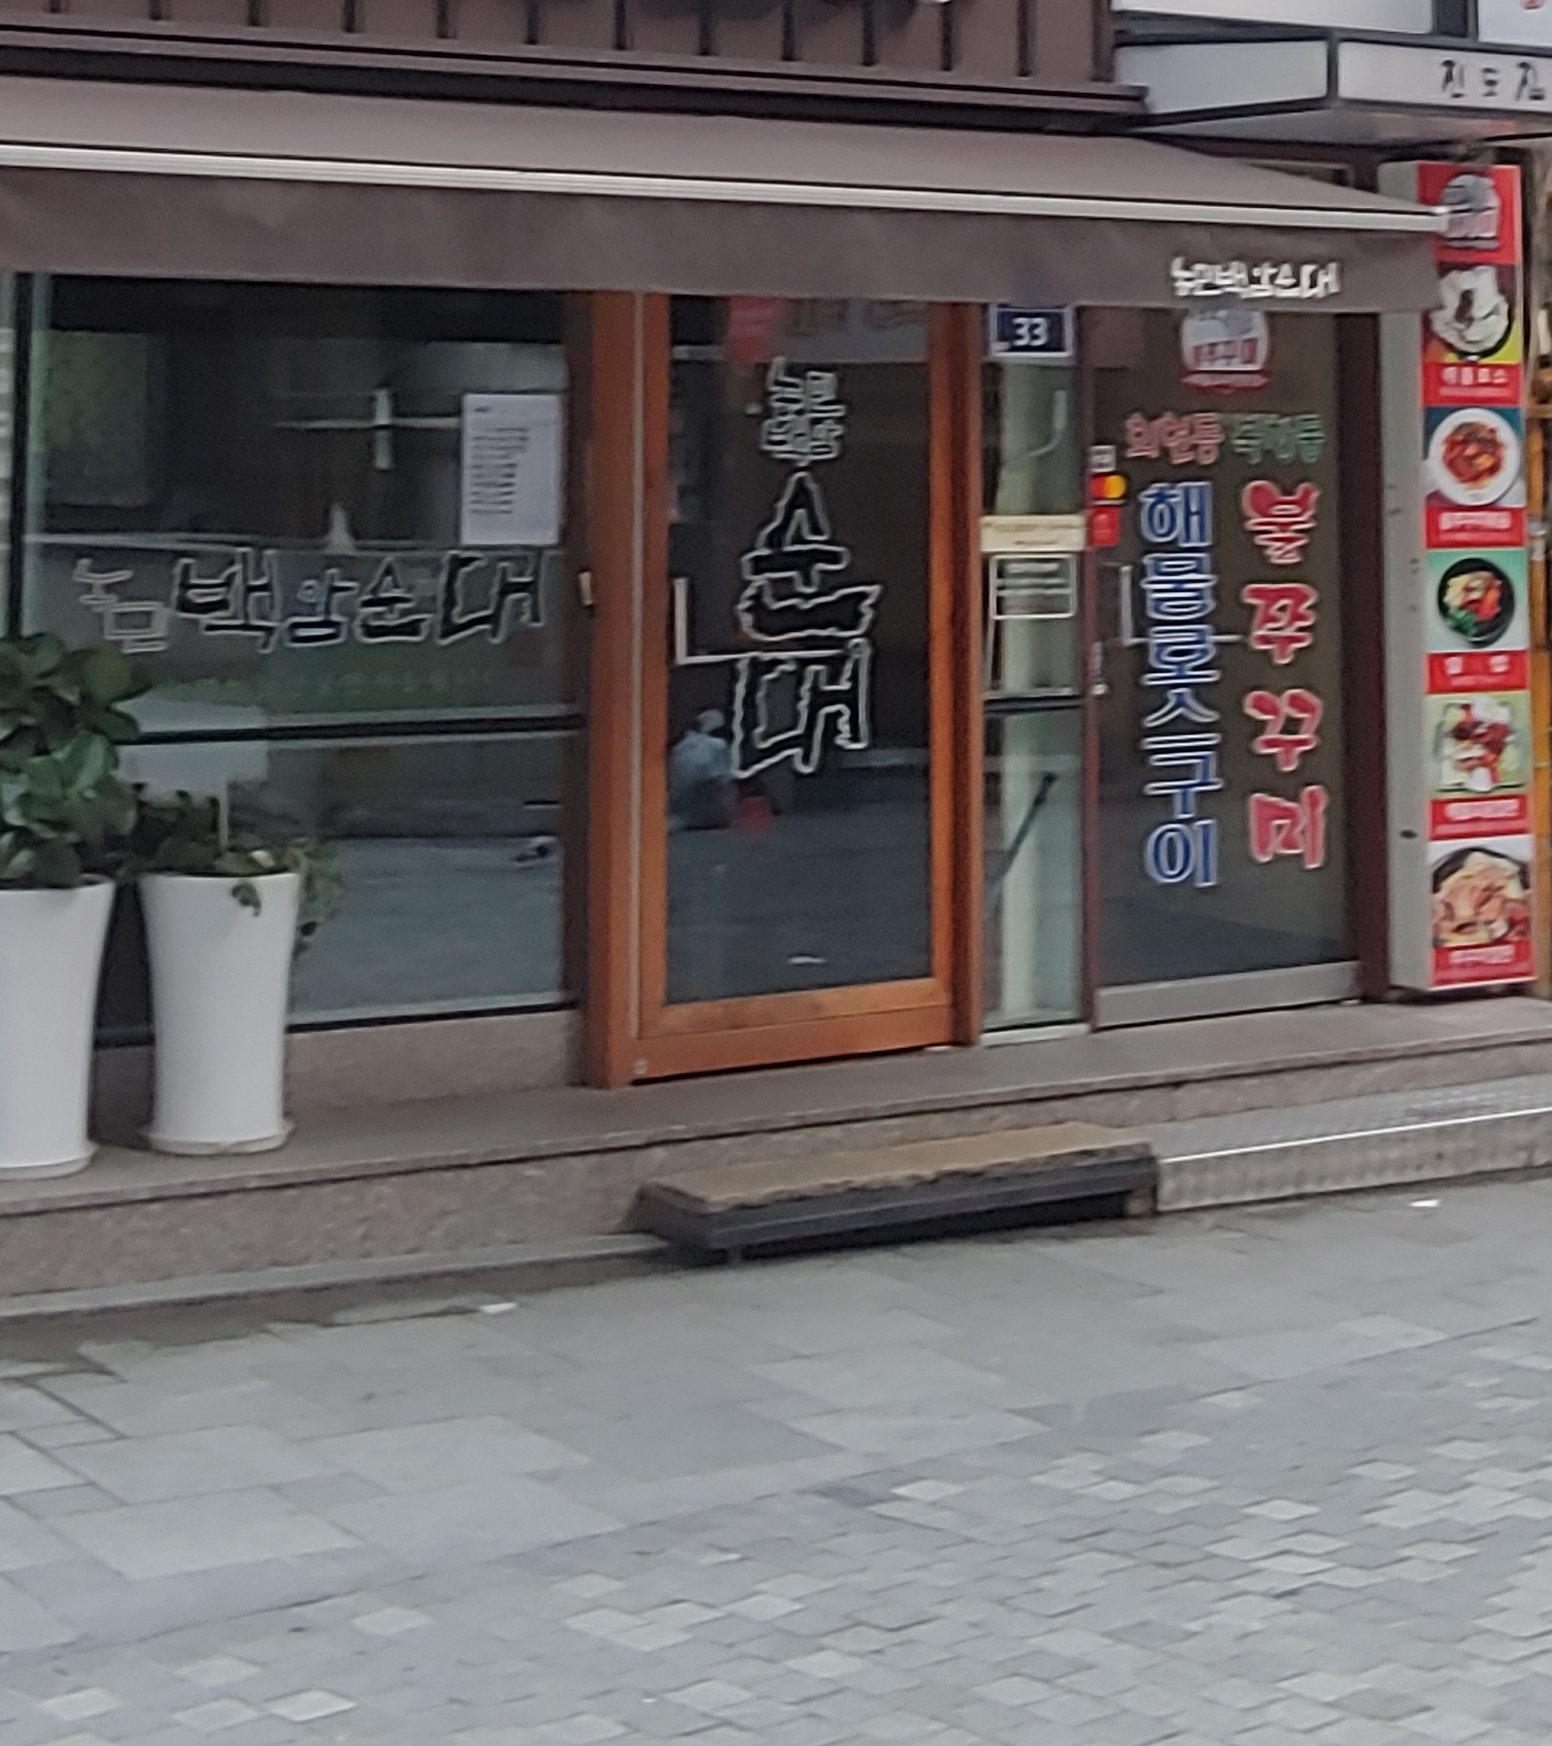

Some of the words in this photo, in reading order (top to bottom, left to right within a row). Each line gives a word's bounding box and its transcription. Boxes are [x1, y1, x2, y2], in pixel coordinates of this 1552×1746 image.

[1013, 316, 1048, 347] 33
[731, 471, 882, 778] 순대
[1140, 480, 1225, 887] 해물로스구이
